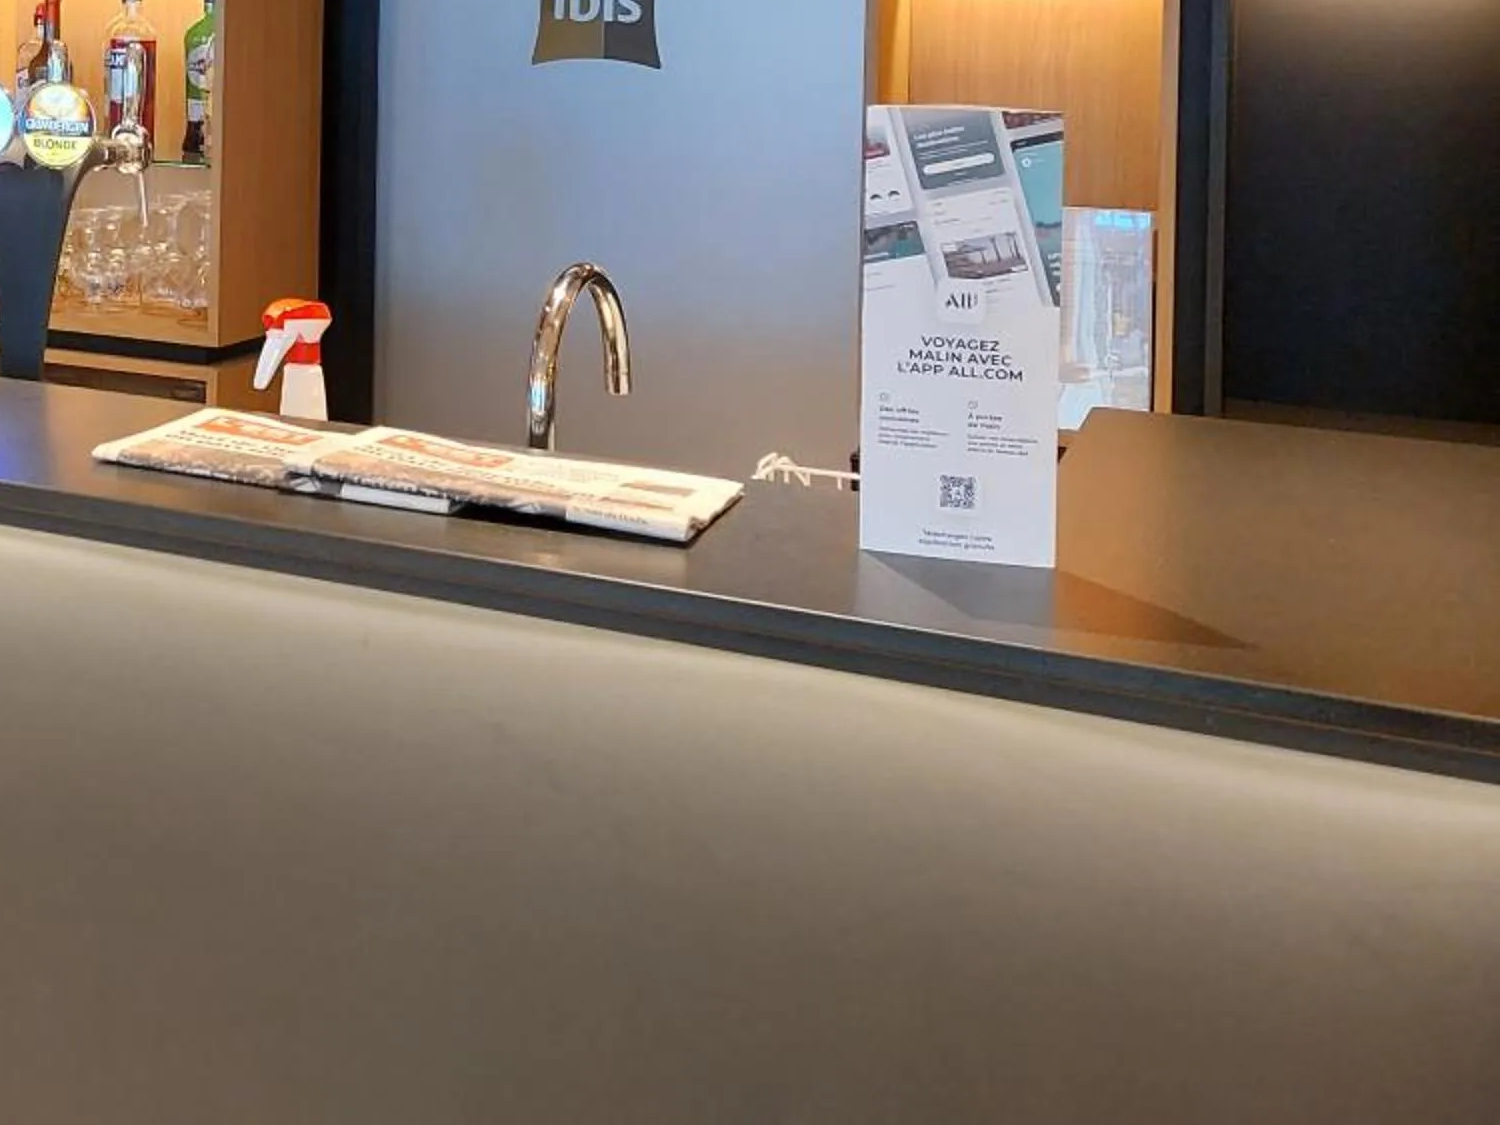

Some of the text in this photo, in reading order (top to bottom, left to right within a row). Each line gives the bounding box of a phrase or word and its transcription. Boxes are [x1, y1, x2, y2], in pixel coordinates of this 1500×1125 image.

[921, 335, 1000, 352] VOYAGEZ
[909, 349, 1012, 367] MALIN AVEC
[897, 361, 1023, 382] L'APP ALL.COM
